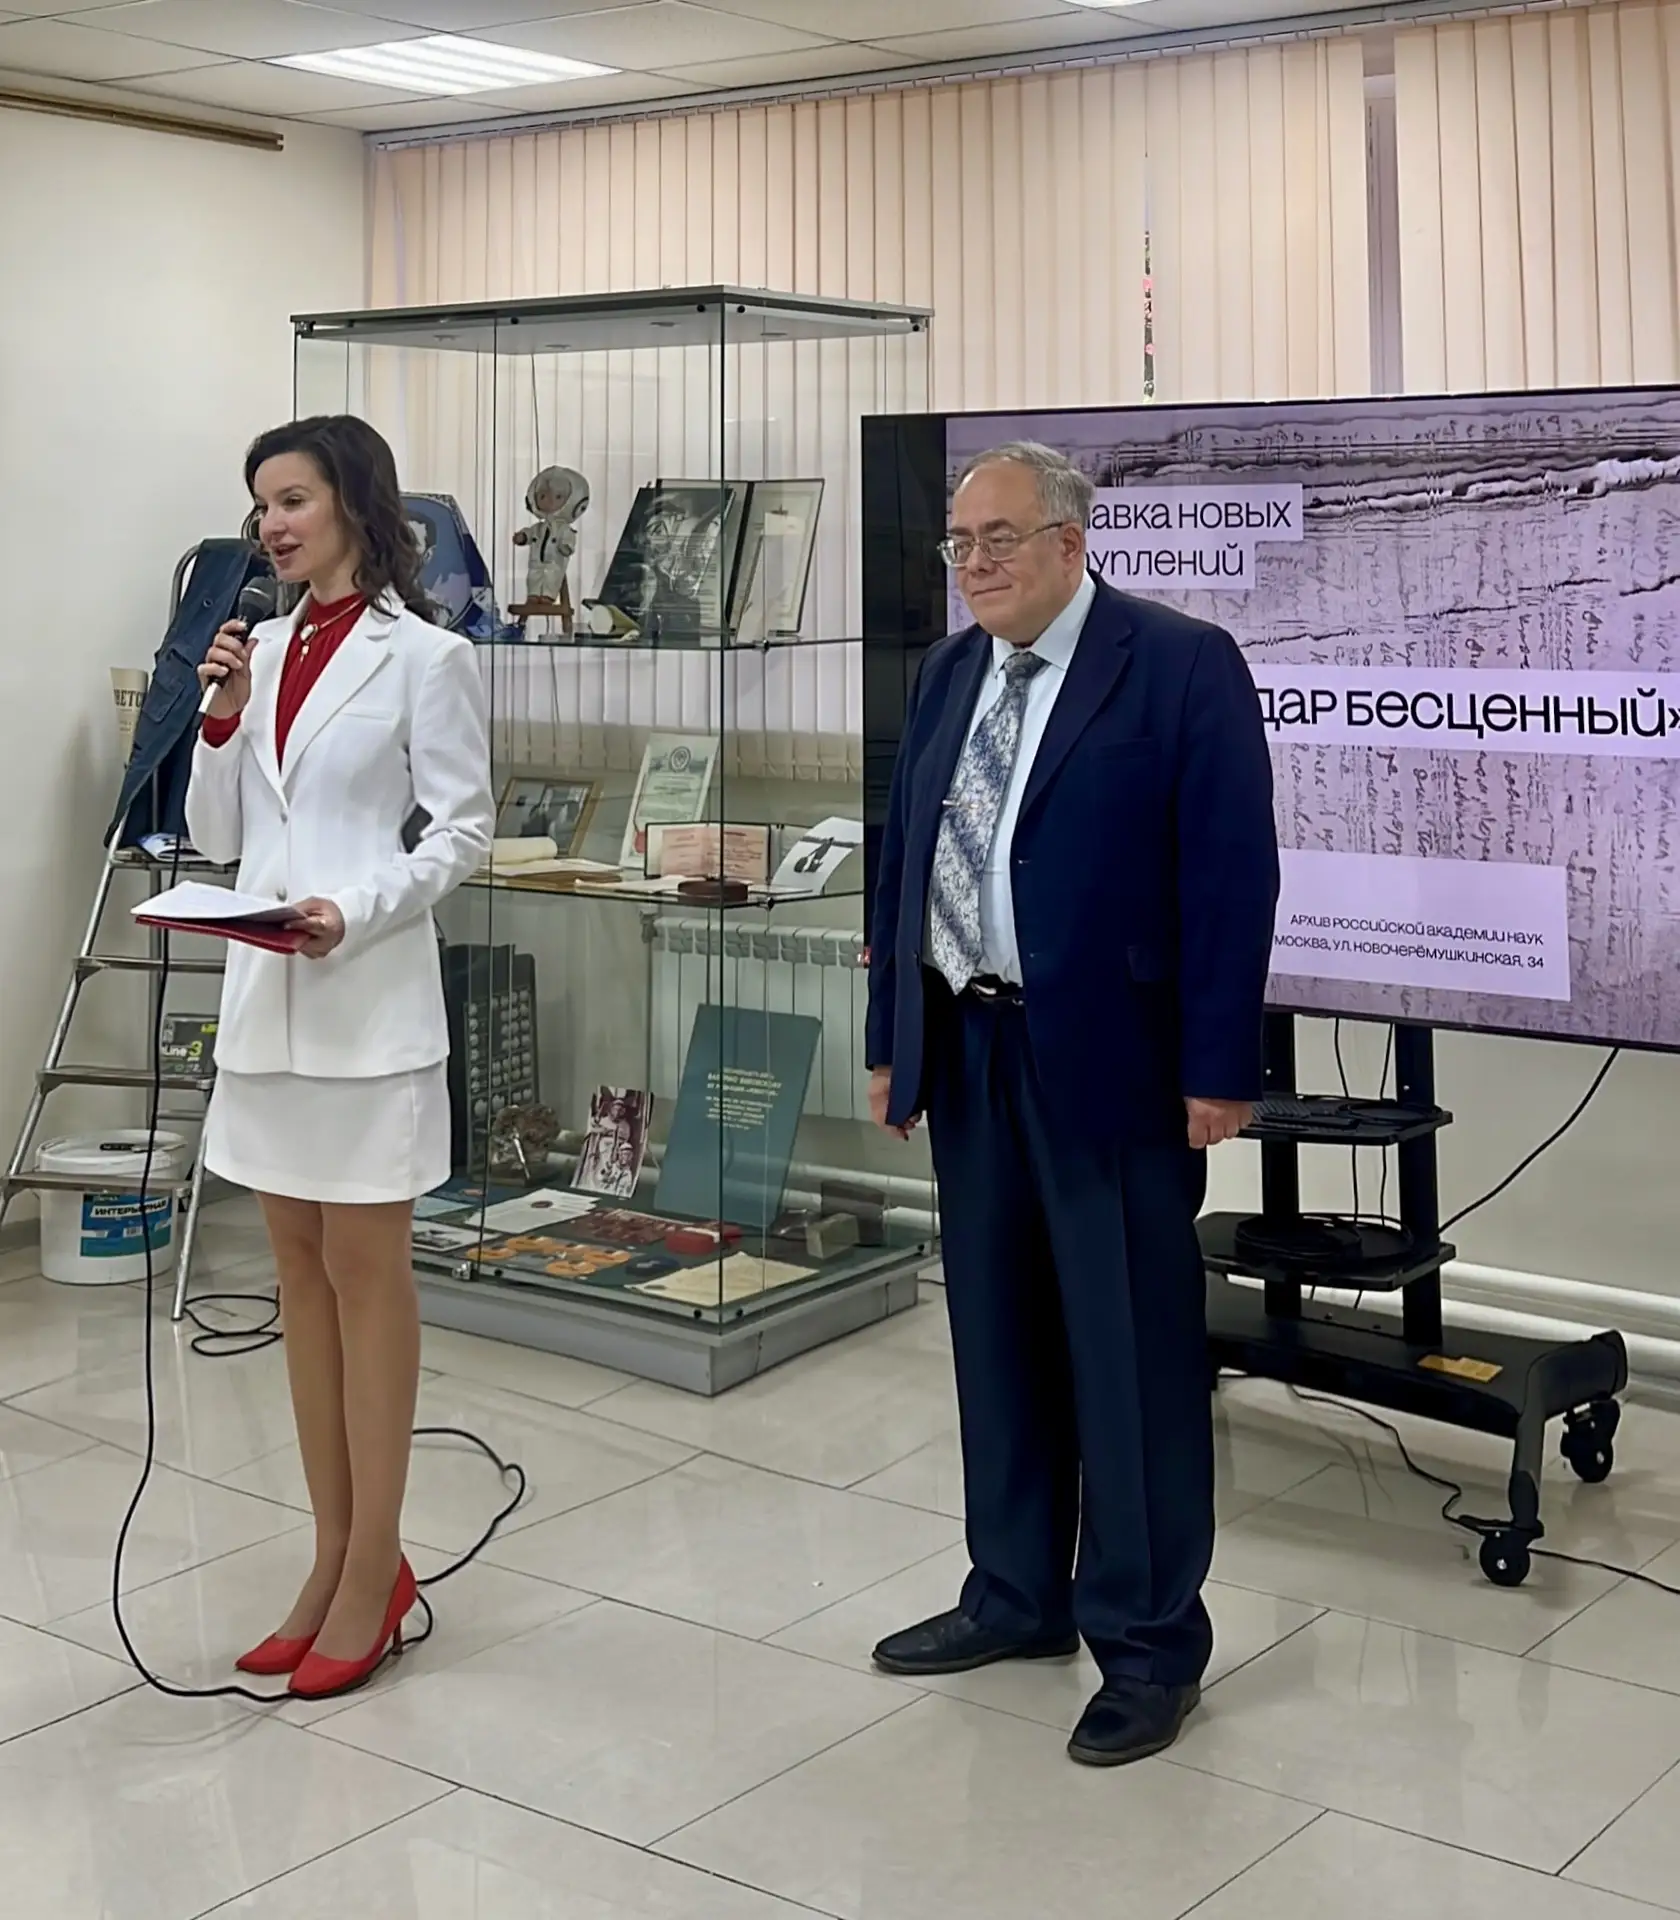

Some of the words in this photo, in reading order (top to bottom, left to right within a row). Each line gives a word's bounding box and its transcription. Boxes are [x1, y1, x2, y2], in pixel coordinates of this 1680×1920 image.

[1086, 503, 1173, 530] авка
[1085, 542, 1244, 576] уплений
[1290, 914, 1331, 928] АРХИВ
[1332, 917, 1424, 936] РОССИЙСКОЙ
[1426, 924, 1505, 942] АКАДЕМИИ
[1507, 930, 1544, 945] НАУК
[1527, 956, 1544, 968] 34
[94, 1199, 167, 1216] ИНТЕРЬРНАЯ
